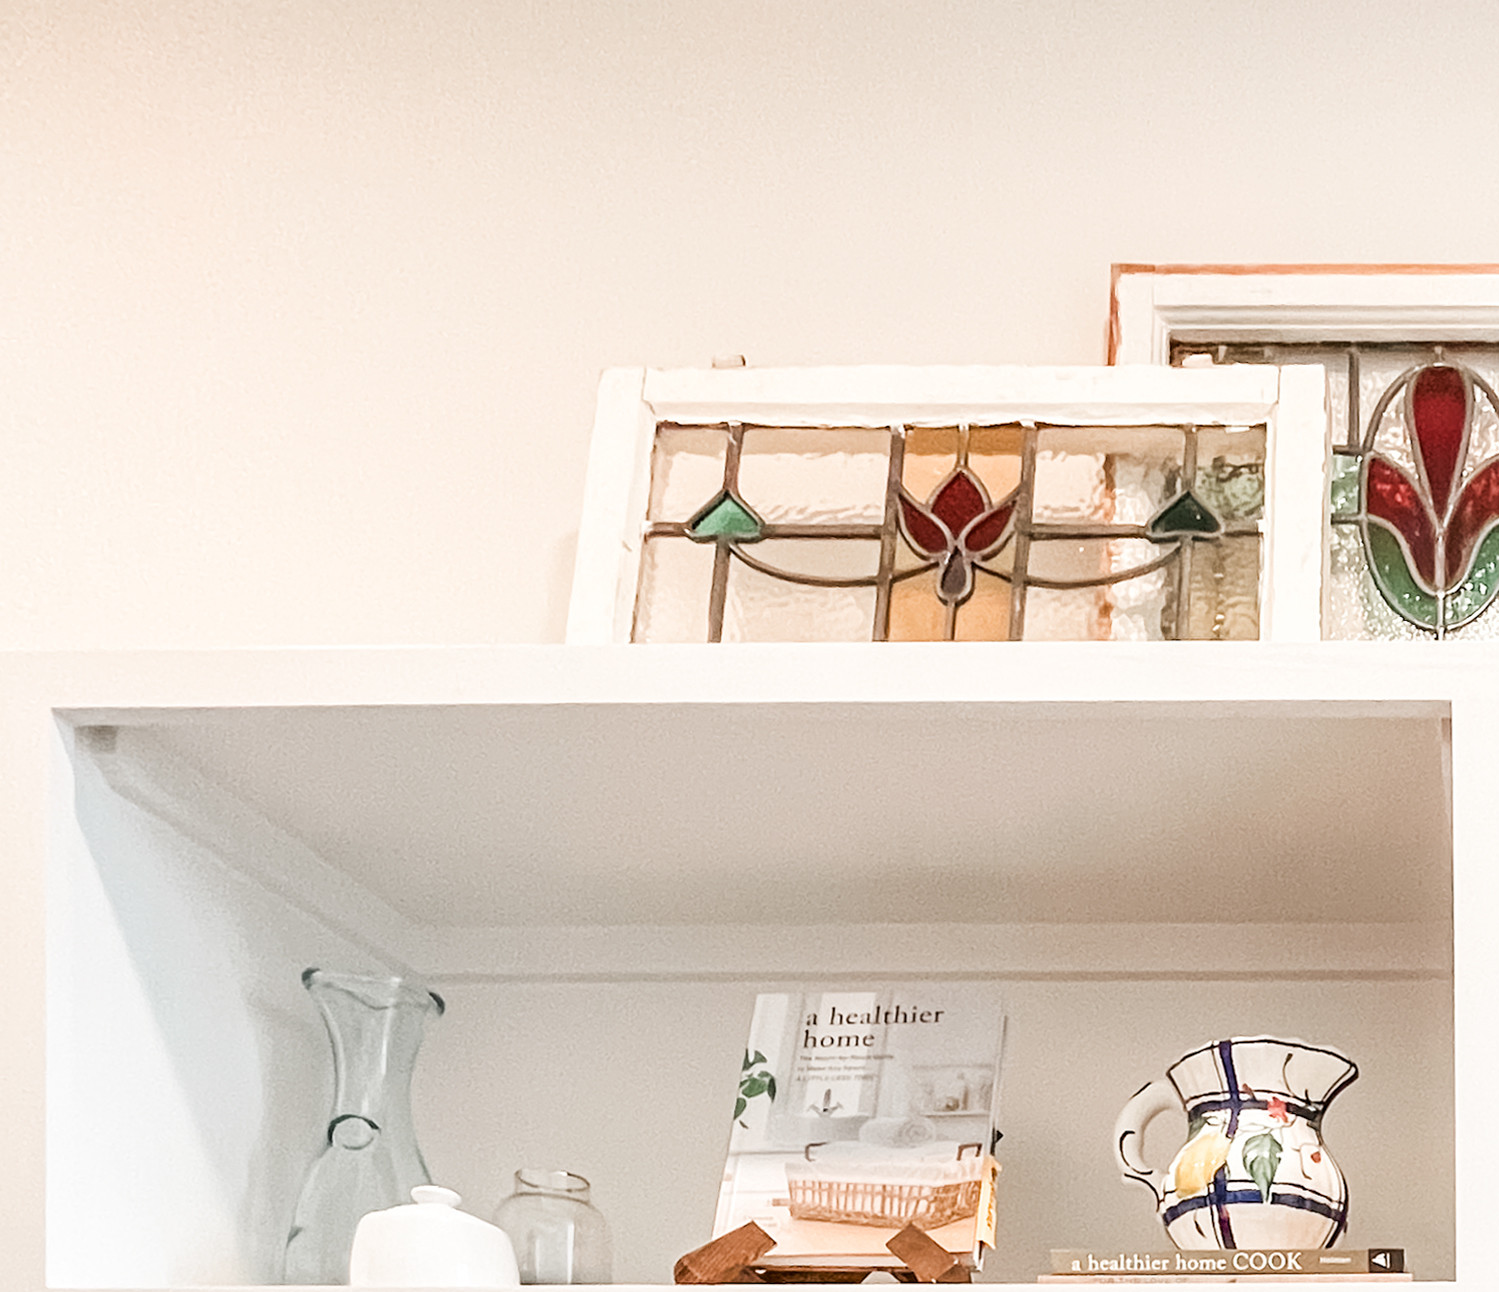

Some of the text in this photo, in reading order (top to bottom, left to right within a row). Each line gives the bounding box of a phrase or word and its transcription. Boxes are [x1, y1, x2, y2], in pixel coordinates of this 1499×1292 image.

[806, 1005, 945, 1026] a healthier
[803, 1029, 875, 1048] home
[1071, 1259, 1081, 1272] a
[1088, 1254, 1169, 1271] healthier
[1175, 1254, 1227, 1271] home
[1233, 1252, 1303, 1271] COOK
